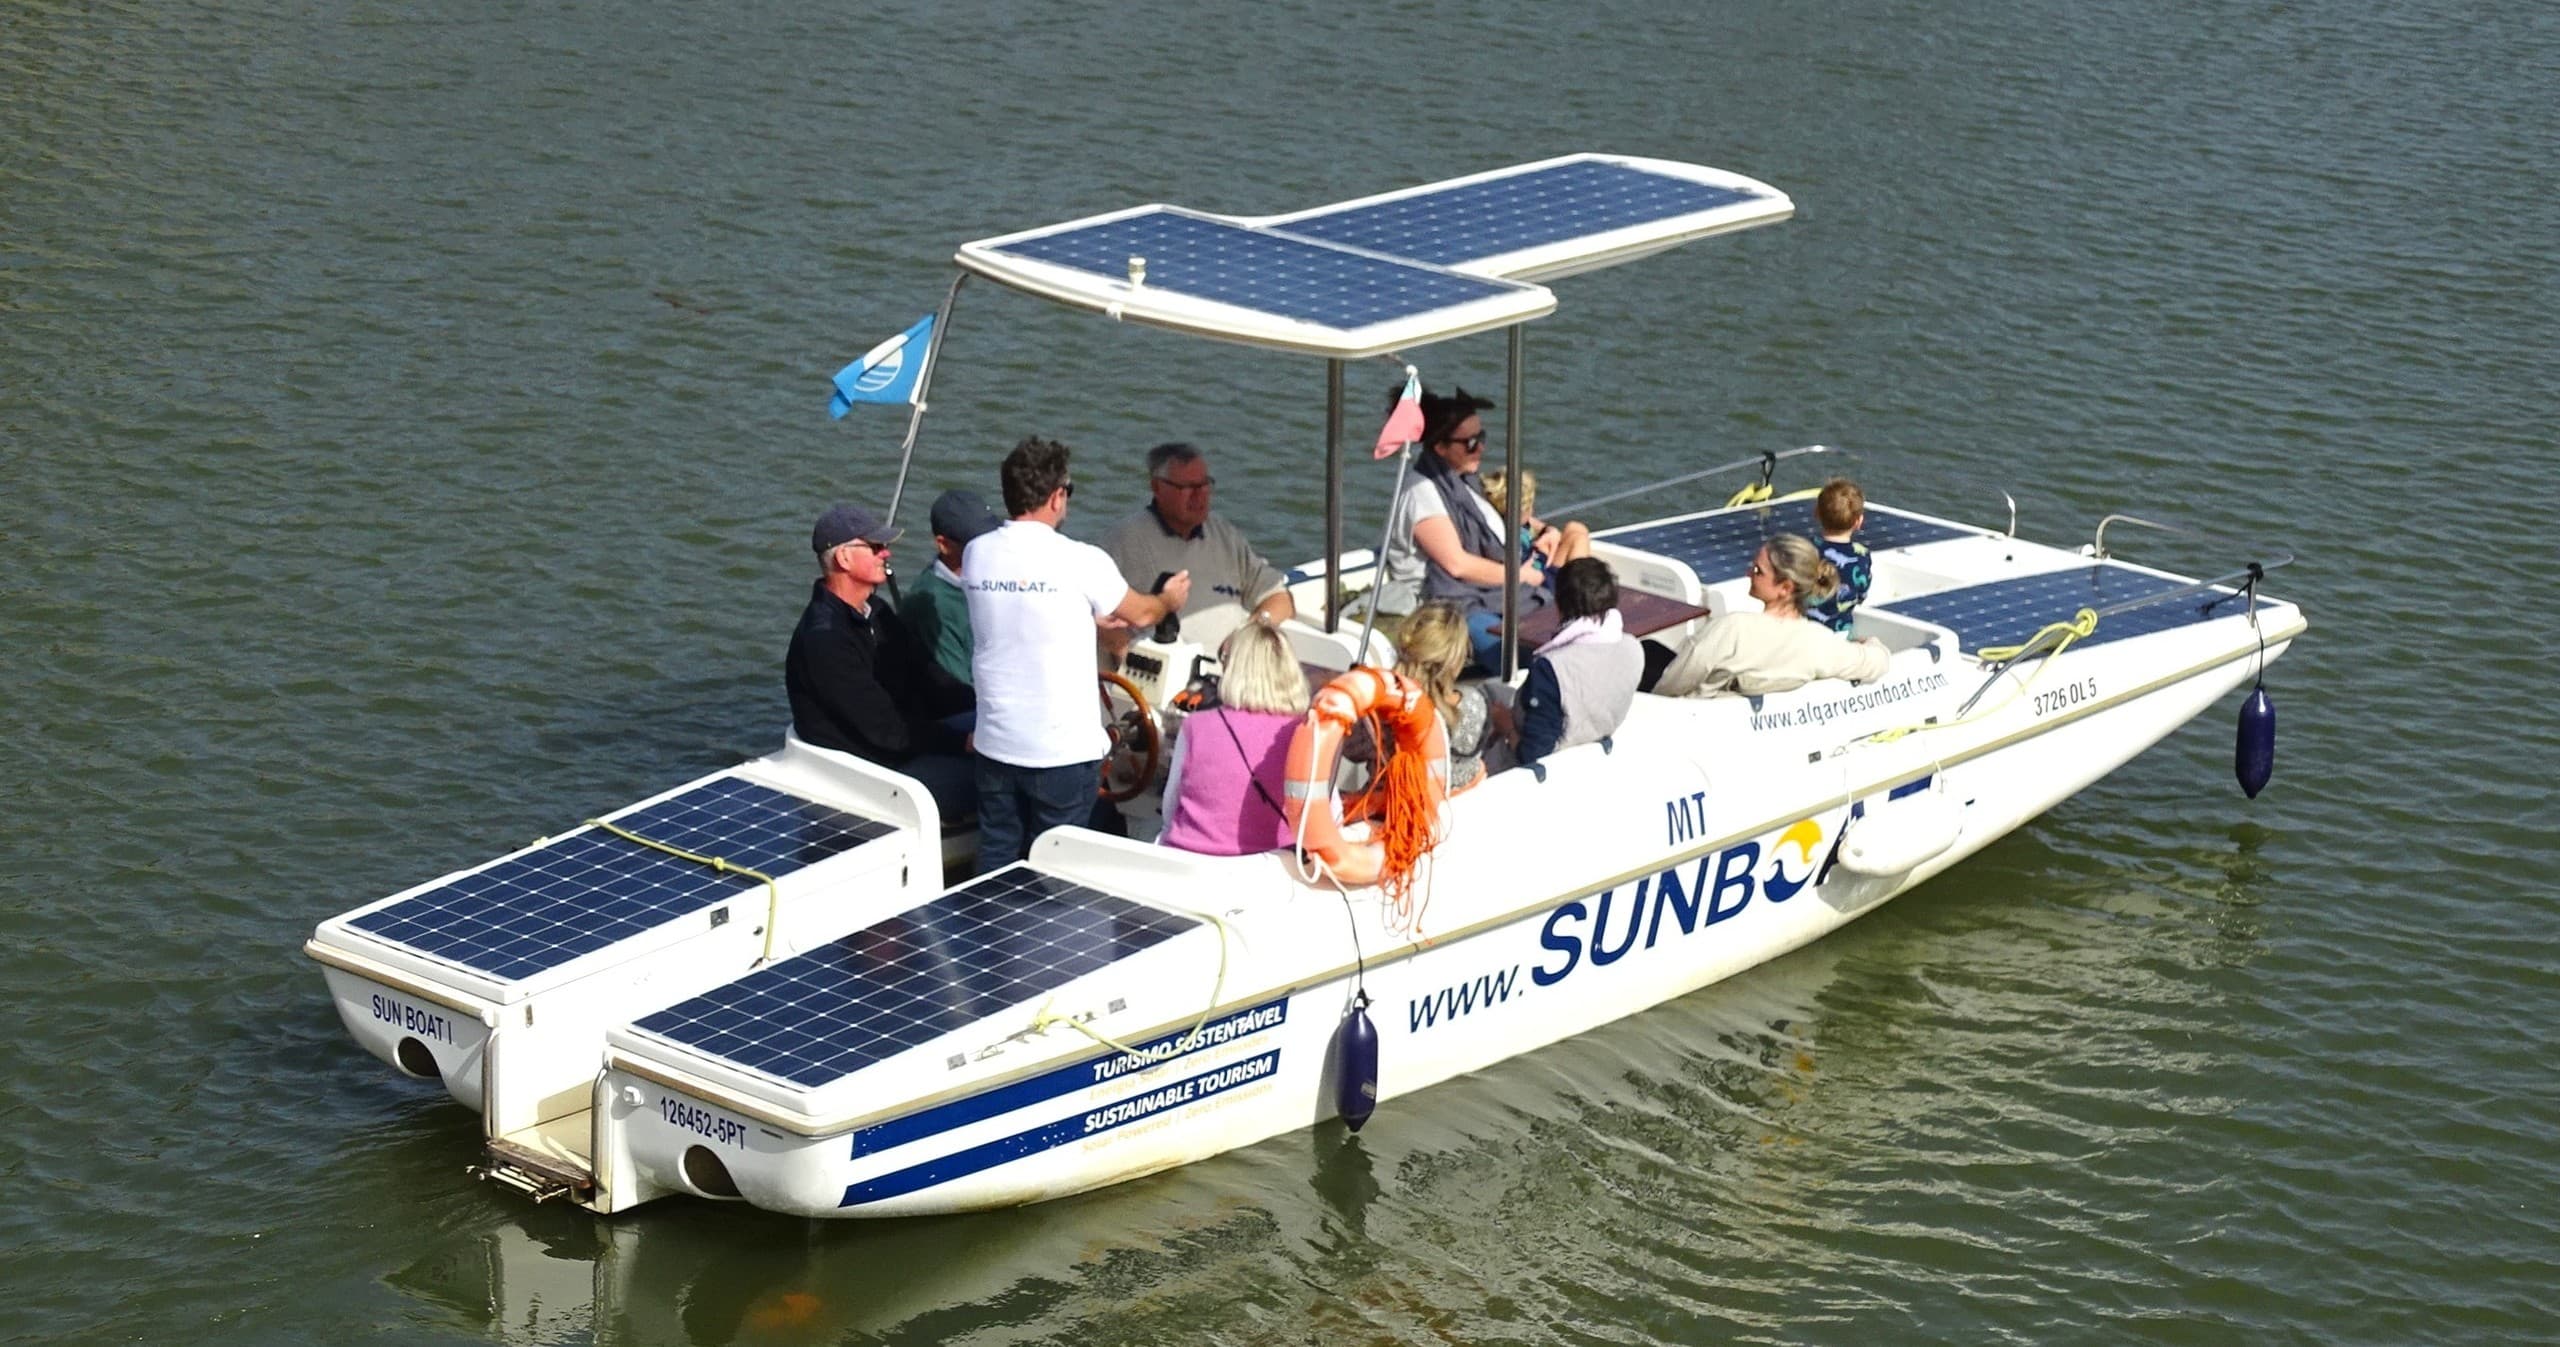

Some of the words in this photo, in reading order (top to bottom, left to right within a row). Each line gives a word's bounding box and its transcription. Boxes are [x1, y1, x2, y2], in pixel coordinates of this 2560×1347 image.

[1750, 672, 1949, 731] www.algarvesunboat.com
[2034, 688, 2067, 716] 3726
[2089, 677, 2097, 698] 5
[1667, 791, 1706, 846] MT
[372, 994, 402, 1027] SUN
[405, 1005, 444, 1040] BOAT
[1093, 1040, 1171, 1081] TURISMO
[1175, 1005, 1284, 1053] SUSTENTÁVEL
[1084, 1082, 1195, 1132] SUSTAINABLE
[1197, 1055, 1273, 1094] TOURISM
[661, 1096, 747, 1150] 126452-5PT
